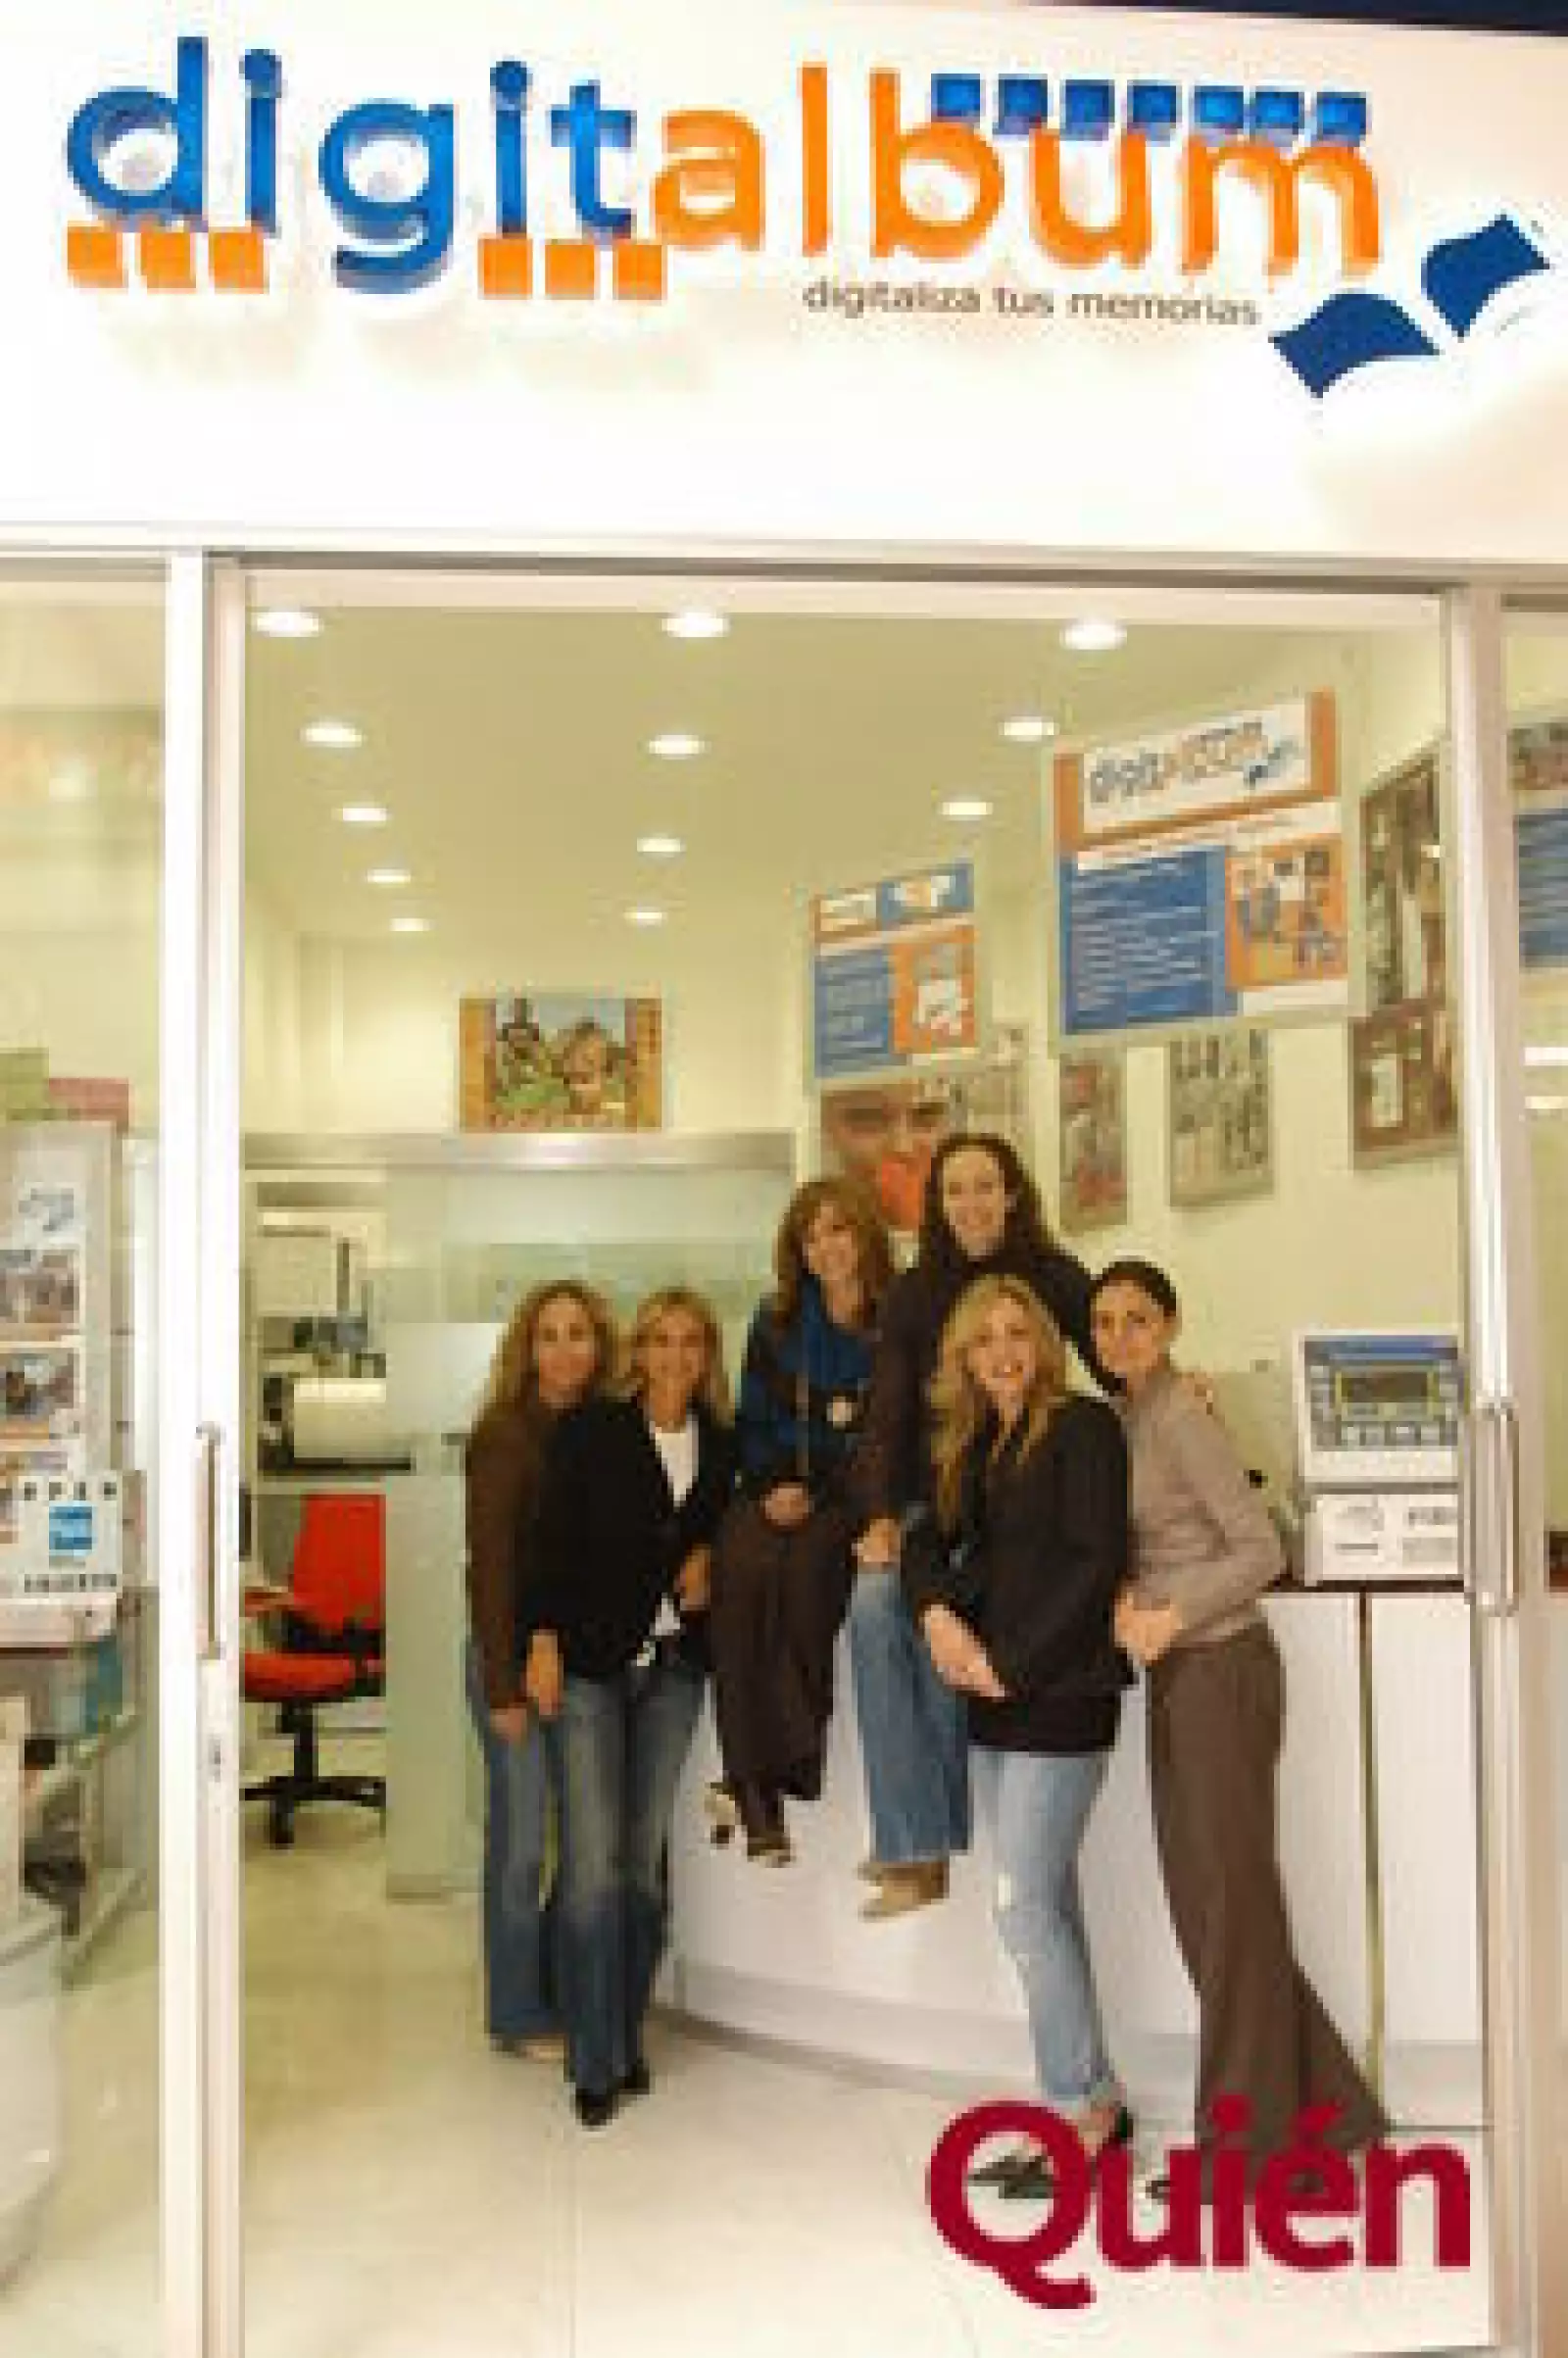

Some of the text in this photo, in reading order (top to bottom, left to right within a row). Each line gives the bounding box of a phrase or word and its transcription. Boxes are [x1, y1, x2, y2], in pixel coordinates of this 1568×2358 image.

[65, 36, 1382, 294] digitalbum
[804, 279, 1259, 325] digitaliza tus memorias
